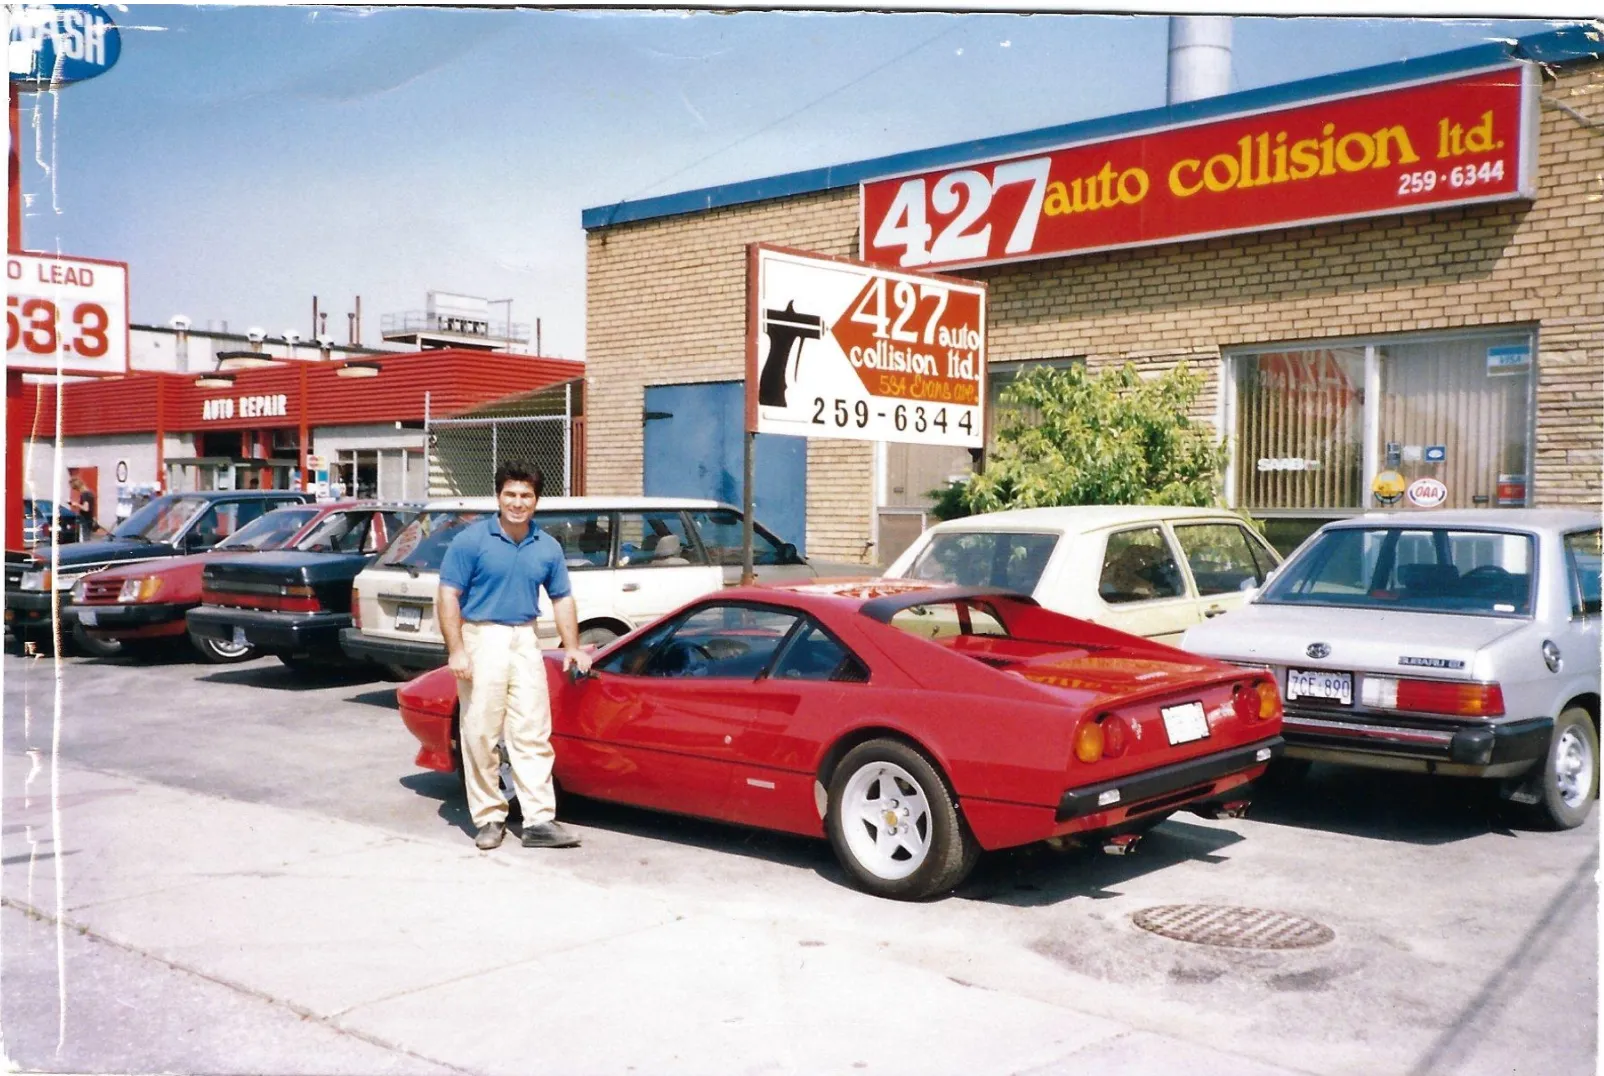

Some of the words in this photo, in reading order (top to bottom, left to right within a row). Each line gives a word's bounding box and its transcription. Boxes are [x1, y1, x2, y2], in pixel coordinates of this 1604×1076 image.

[872, 156, 1051, 267] 427
[1043, 161, 1149, 216] auto
[1168, 122, 1420, 197] collision
[1437, 110, 1504, 158] ltd.
[38, 263, 94, 287] LEAD
[850, 278, 950, 345] 427
[938, 322, 980, 351] auto
[850, 340, 939, 376] collision
[947, 348, 980, 381] ltd.
[203, 398, 234, 420] AUTO
[239, 394, 287, 418] REPAIR
[910, 374, 952, 399] Evans
[954, 383, 979, 402] ave.
[812, 397, 973, 436] 259-6344
